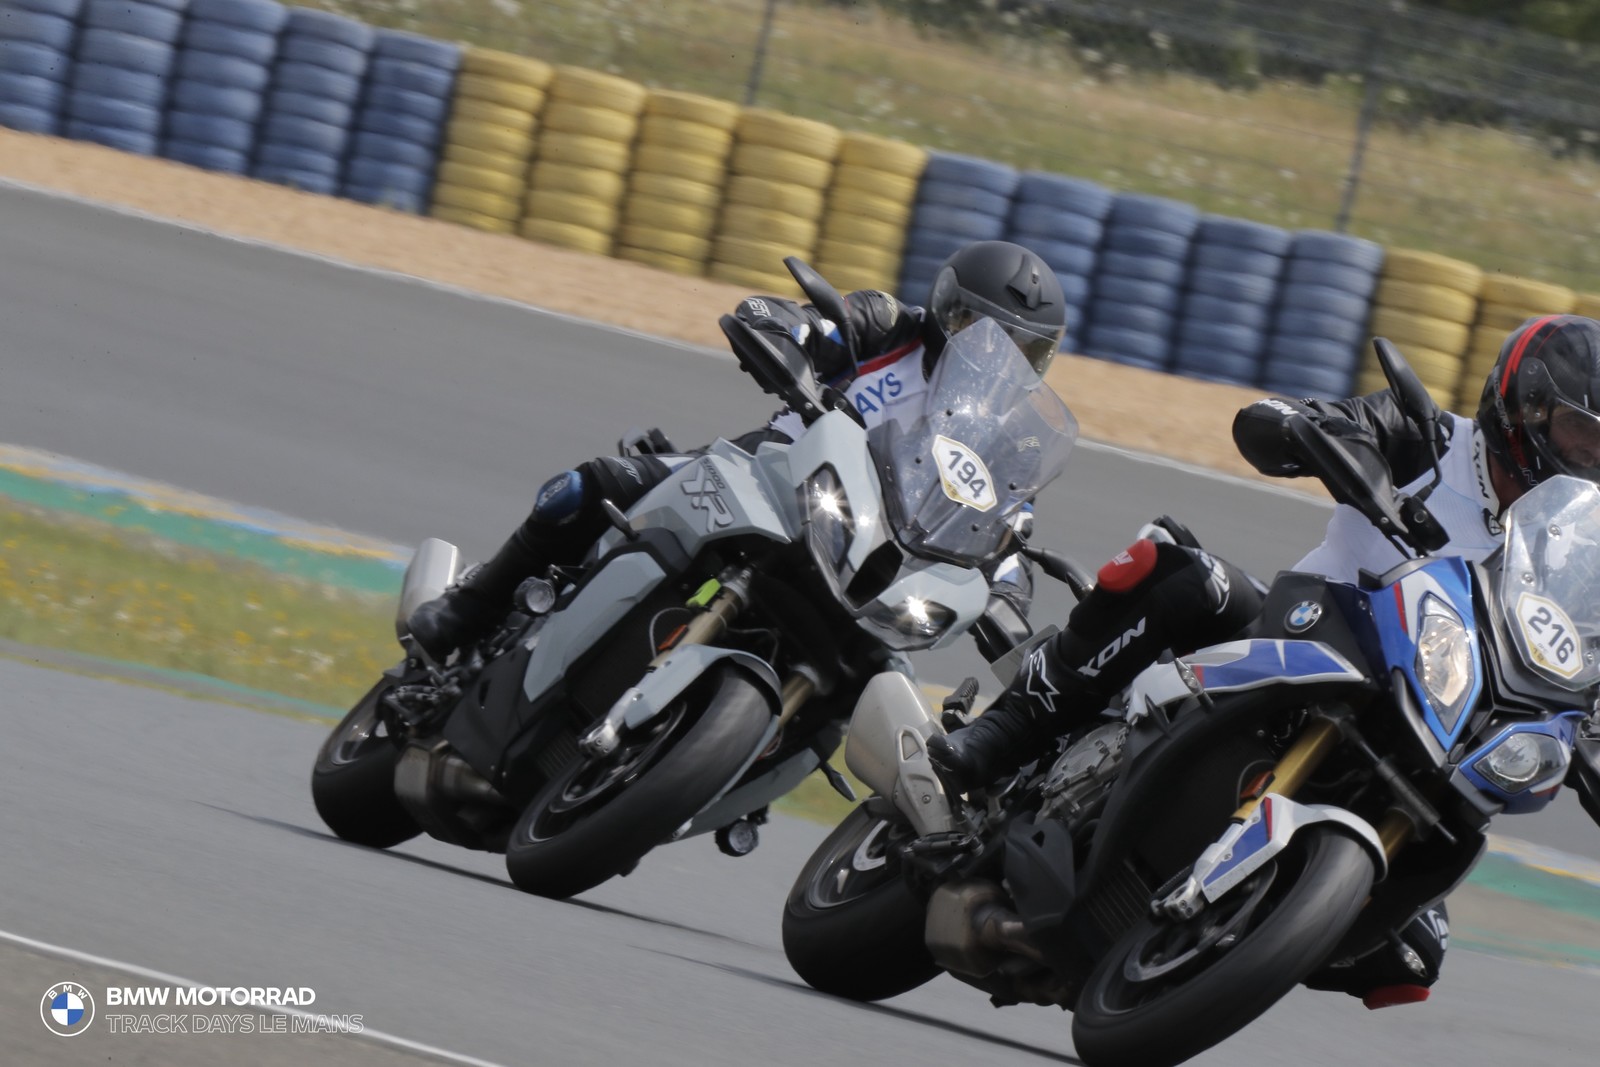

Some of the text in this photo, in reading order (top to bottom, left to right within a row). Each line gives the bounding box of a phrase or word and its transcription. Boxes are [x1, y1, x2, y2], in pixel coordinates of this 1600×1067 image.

[855, 372, 903, 415] AYS
[948, 450, 987, 499] 194
[1528, 606, 1576, 664] 216
